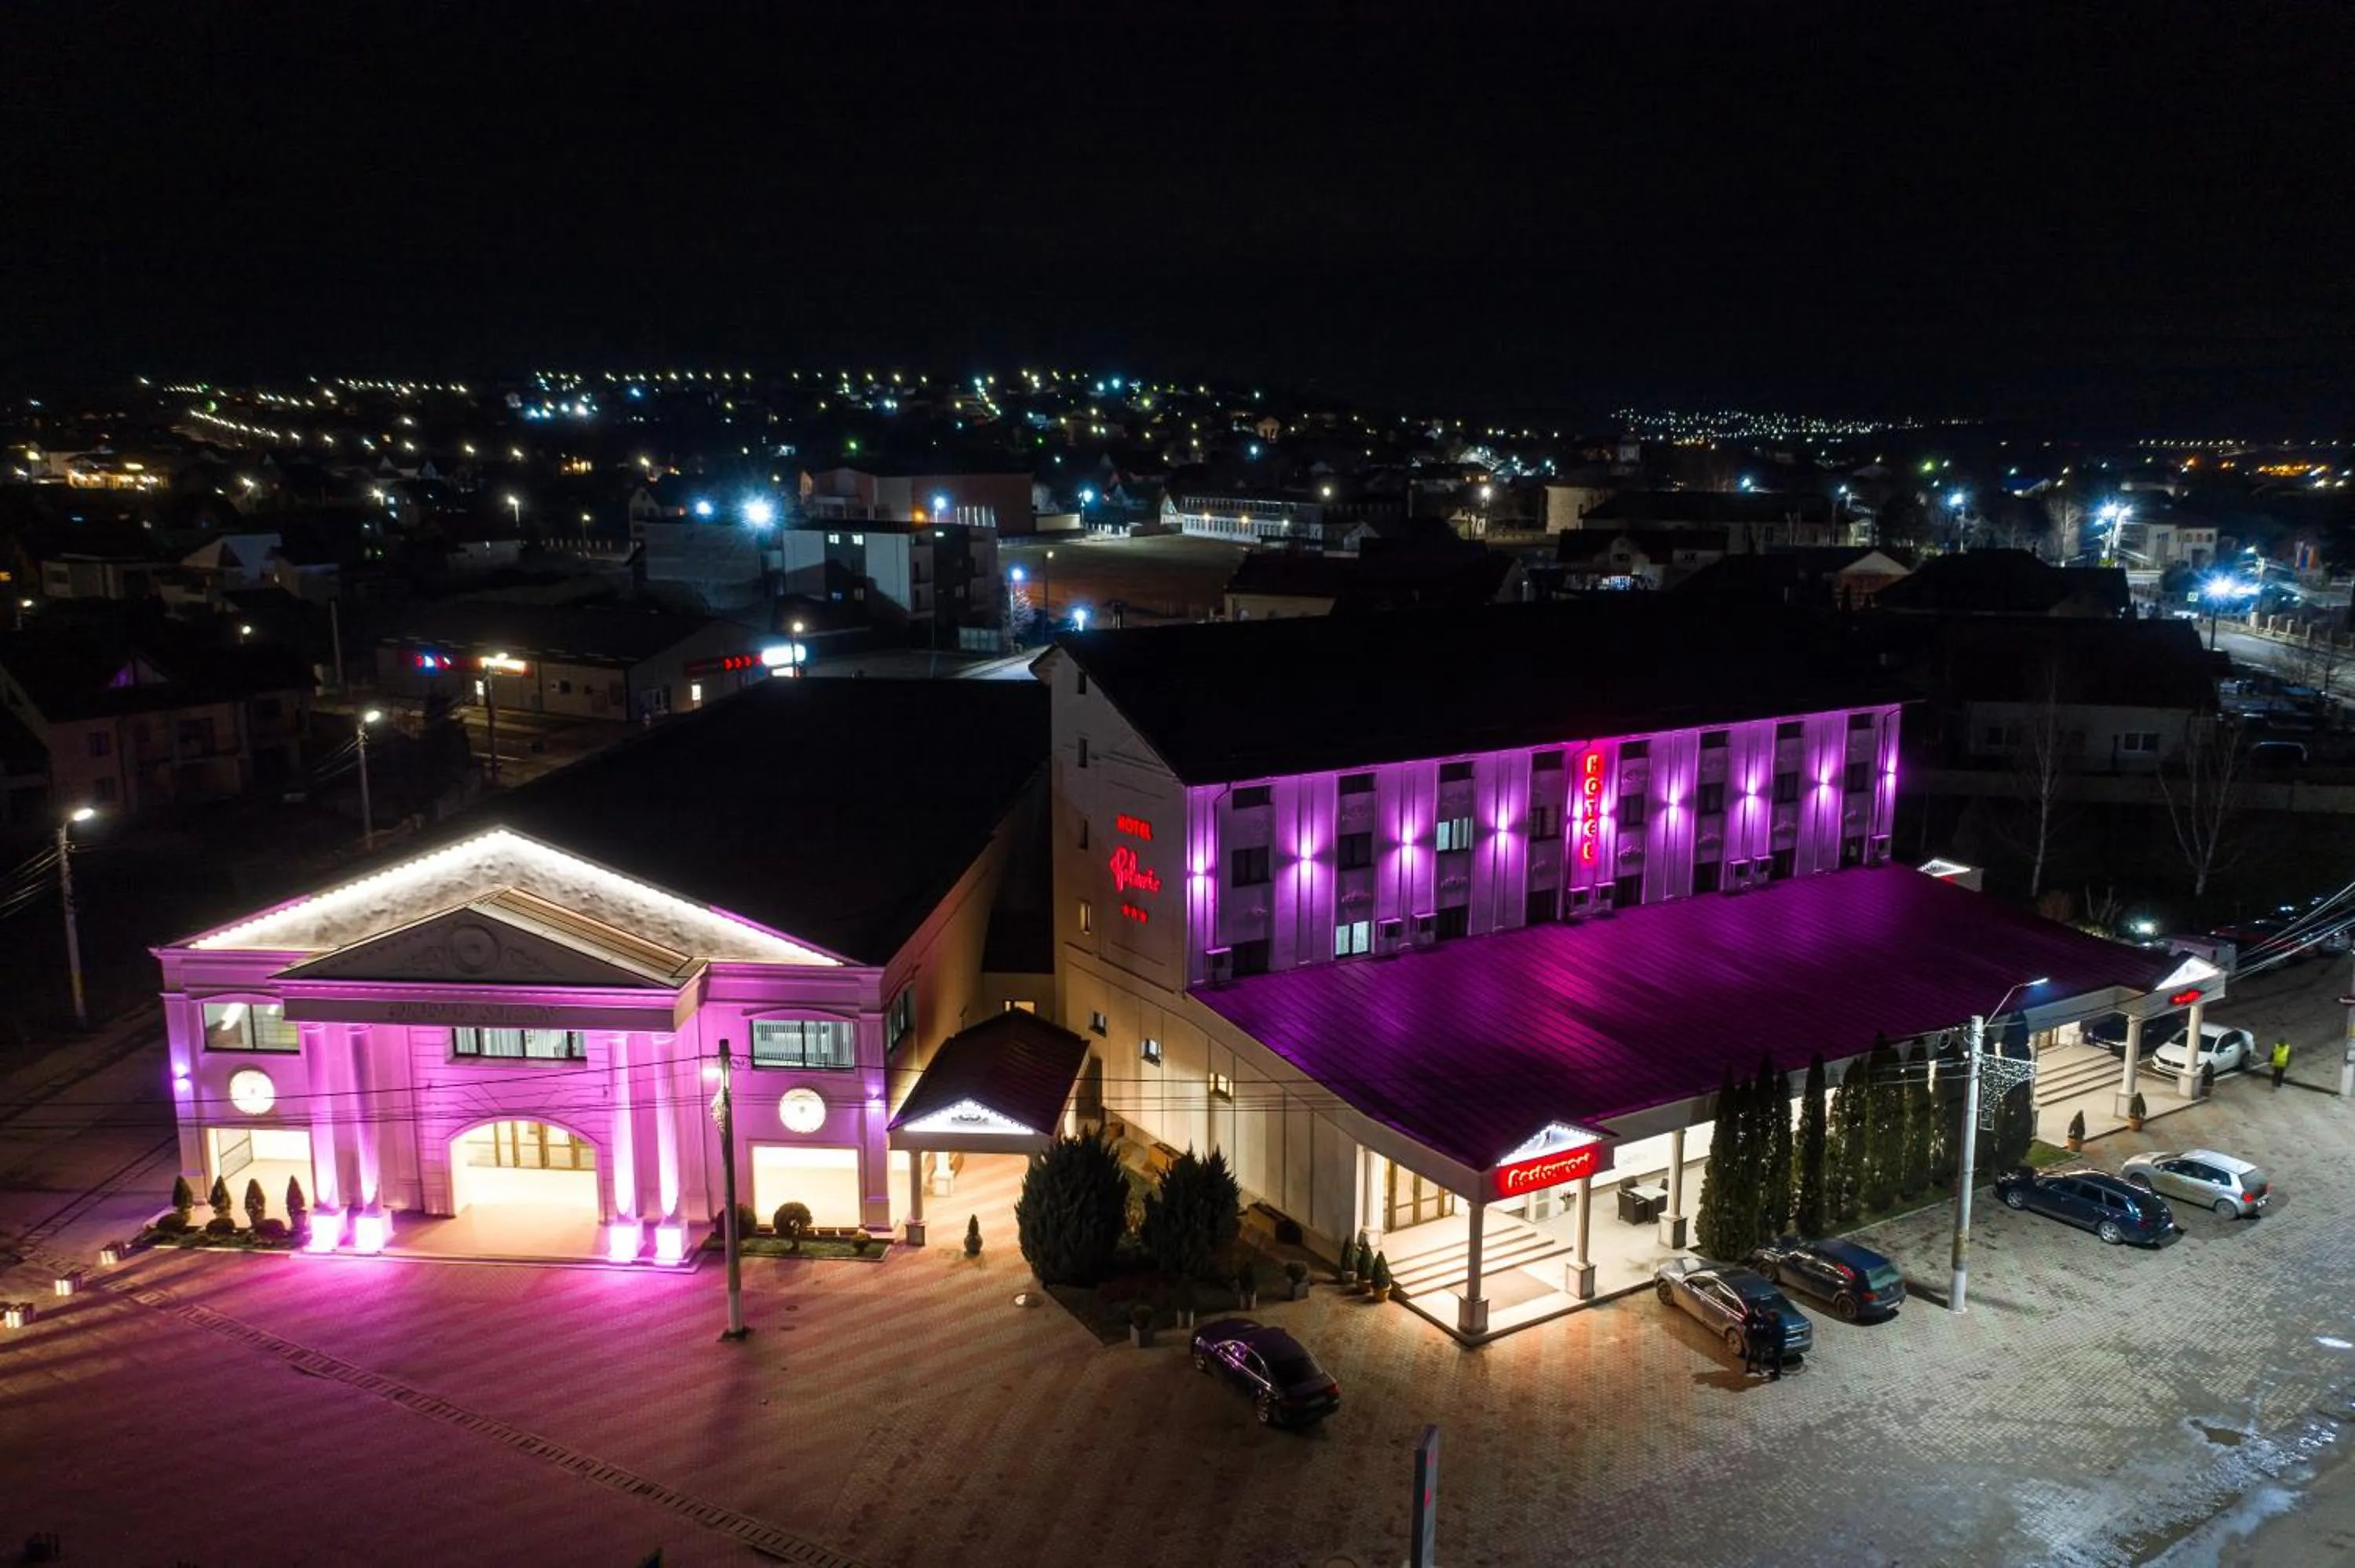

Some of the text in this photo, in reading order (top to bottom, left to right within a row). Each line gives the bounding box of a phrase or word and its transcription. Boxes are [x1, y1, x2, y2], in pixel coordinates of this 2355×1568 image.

[1583, 754, 1600, 859] HOTEL
[1117, 815, 1152, 841] HOTEL
[1509, 1152, 1590, 1188] Restaurant
